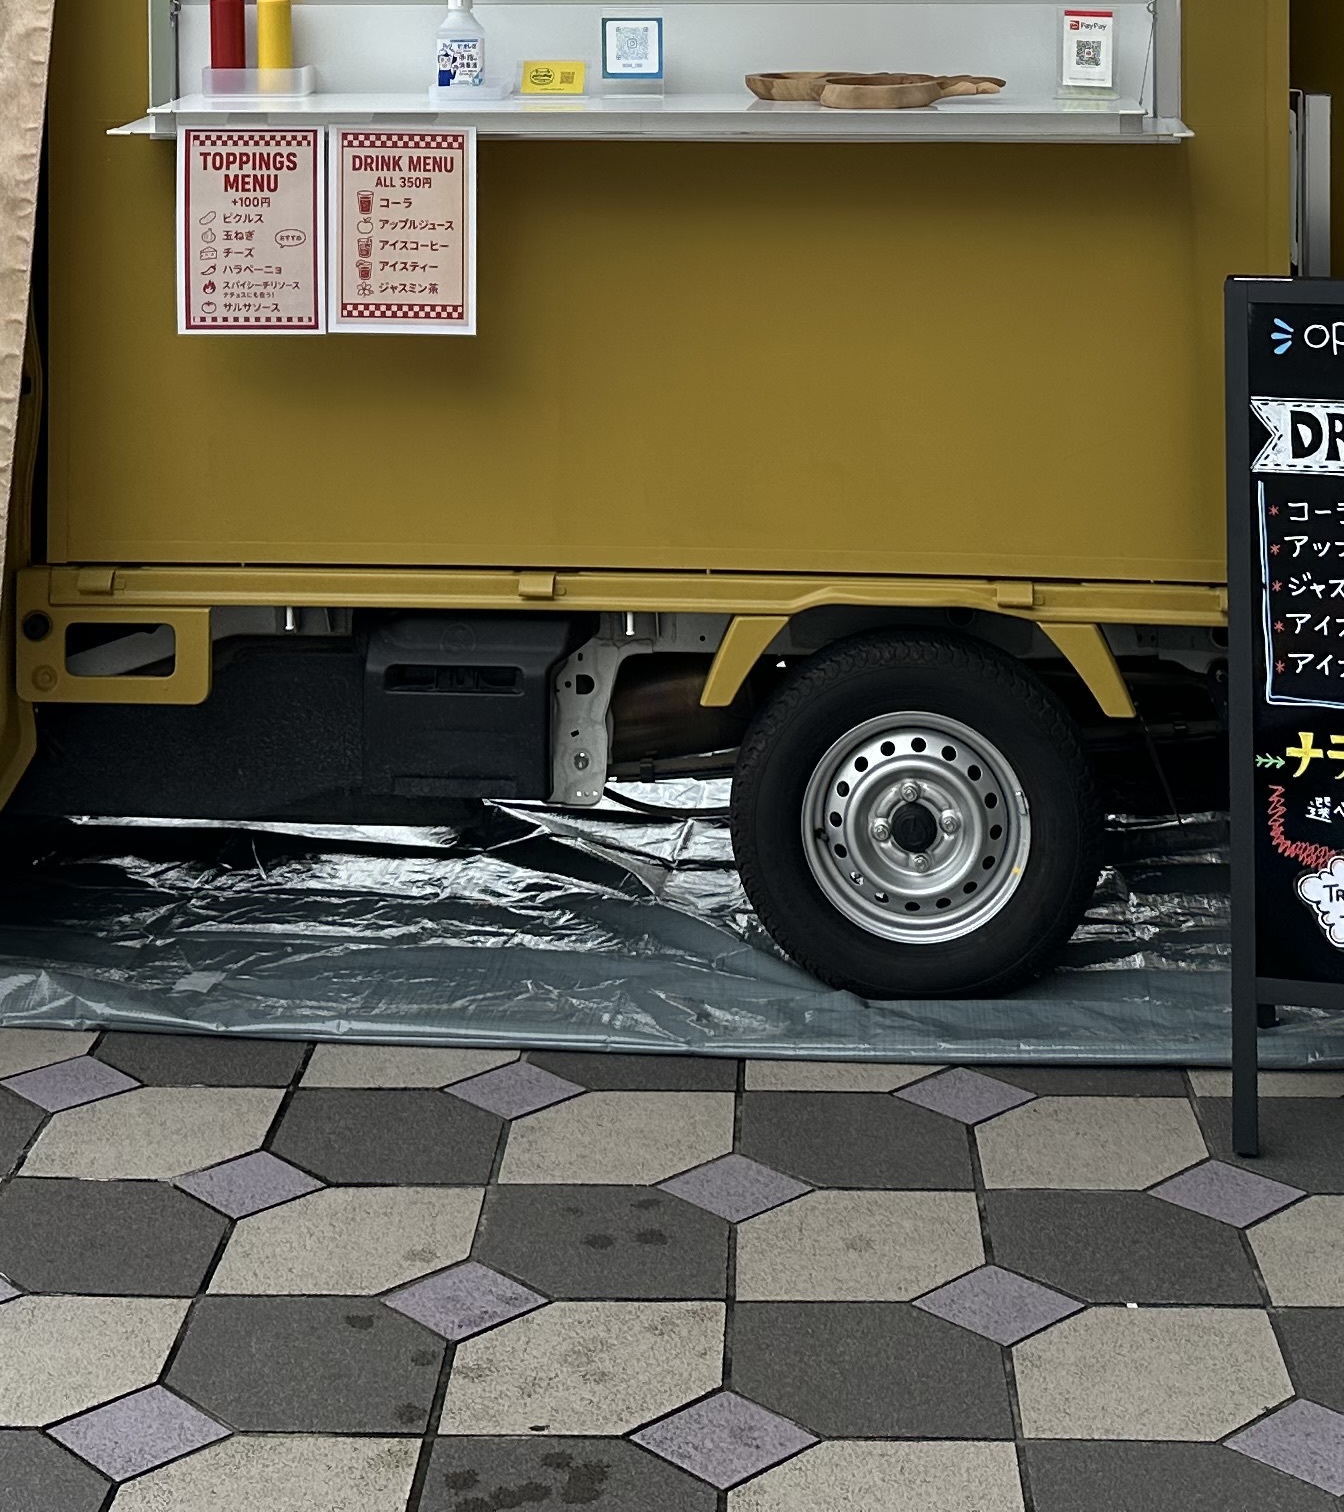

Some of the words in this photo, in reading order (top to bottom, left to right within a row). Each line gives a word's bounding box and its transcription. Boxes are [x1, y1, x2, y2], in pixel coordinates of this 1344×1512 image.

[1080, 22, 1107, 31] PayPay
[199, 152, 298, 171] TOPPINGS
[351, 154, 403, 172] DRINK
[408, 156, 454, 173] MENU
[224, 174, 279, 193] MENU
[375, 176, 396, 188] ALL
[399, 177, 432, 189] 350円
[231, 196, 271, 208] +100円
[379, 197, 413, 209] コーラ
[223, 212, 264, 223] ピクルス
[379, 218, 455, 231] アップルジュース
[223, 230, 255, 241] 玉ねぎ
[379, 240, 449, 251] アイスコーヒー
[223, 247, 255, 258] チーズ
[223, 264, 282, 275] ハラペーニョ
[379, 261, 439, 272] アイスティー
[223, 281, 300, 290] スパイシーチリソース
[378, 282, 439, 294] ジャスミン茶
[223, 302, 280, 313] サルサソース
